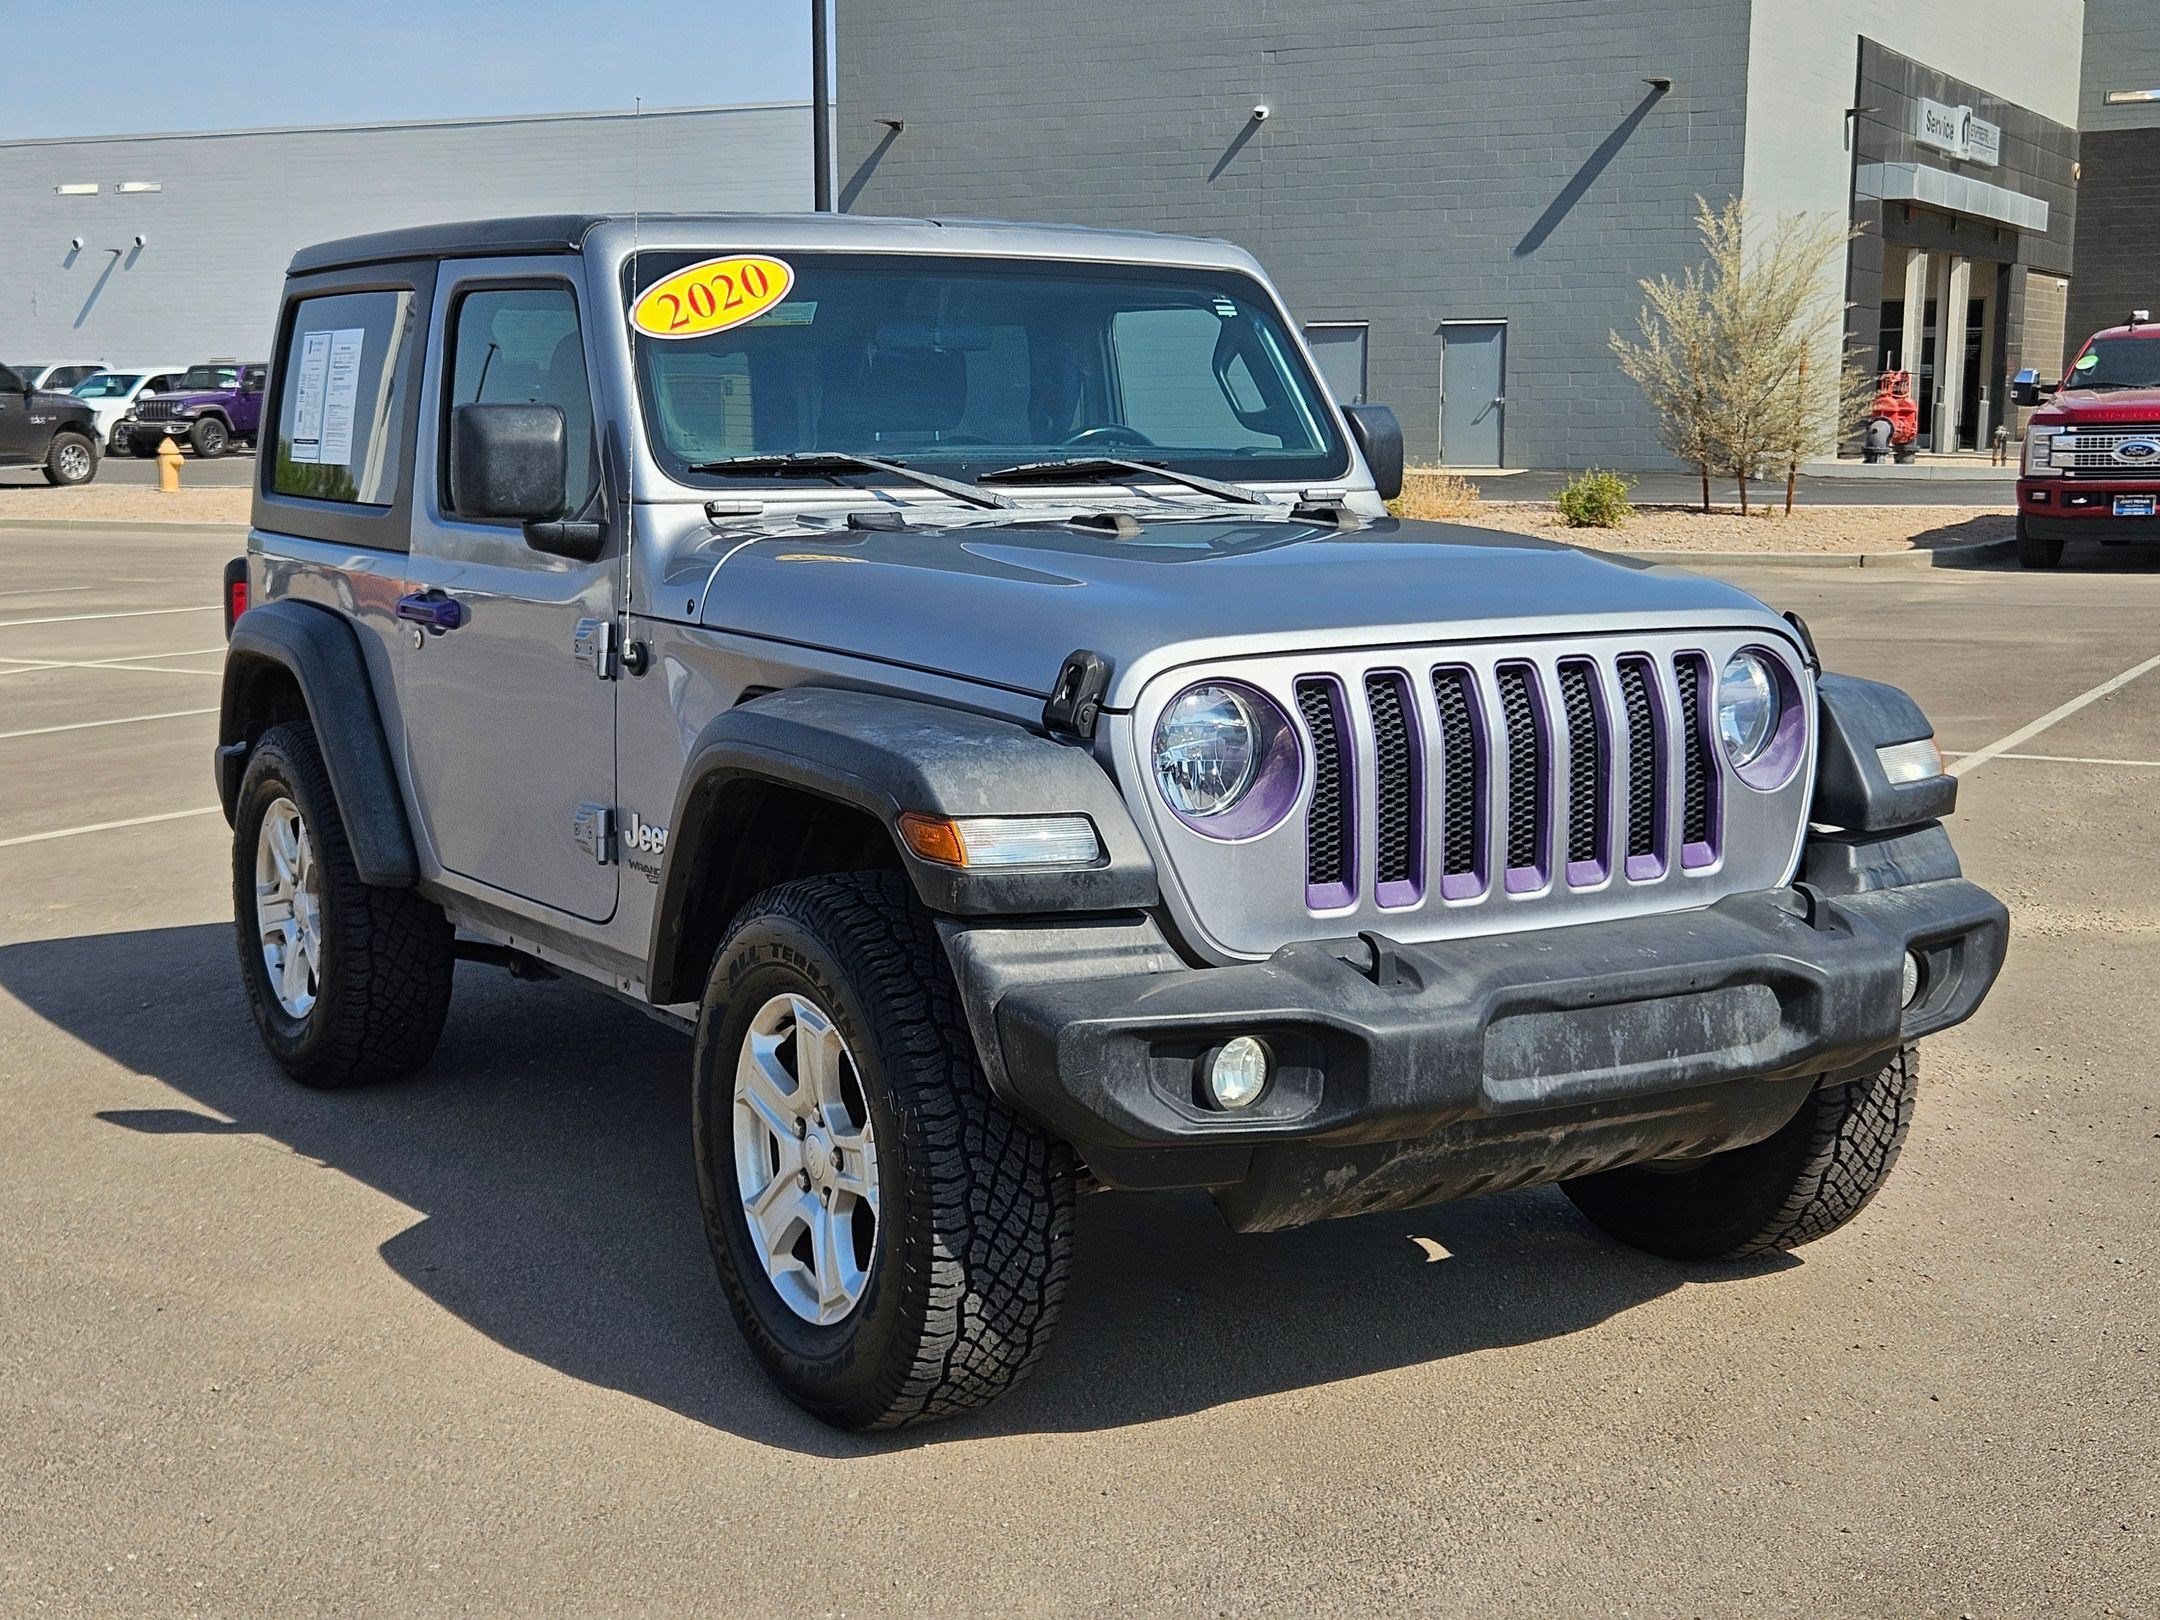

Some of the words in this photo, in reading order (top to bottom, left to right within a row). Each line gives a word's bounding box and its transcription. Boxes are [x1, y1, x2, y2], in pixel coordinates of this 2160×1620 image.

[1926, 109, 1954, 140] Service
[656, 264, 769, 331] 2020
[2125, 446, 2149, 456] Ford
[729, 945, 760, 986] ALL
[770, 942, 857, 1038] TERRAIN
